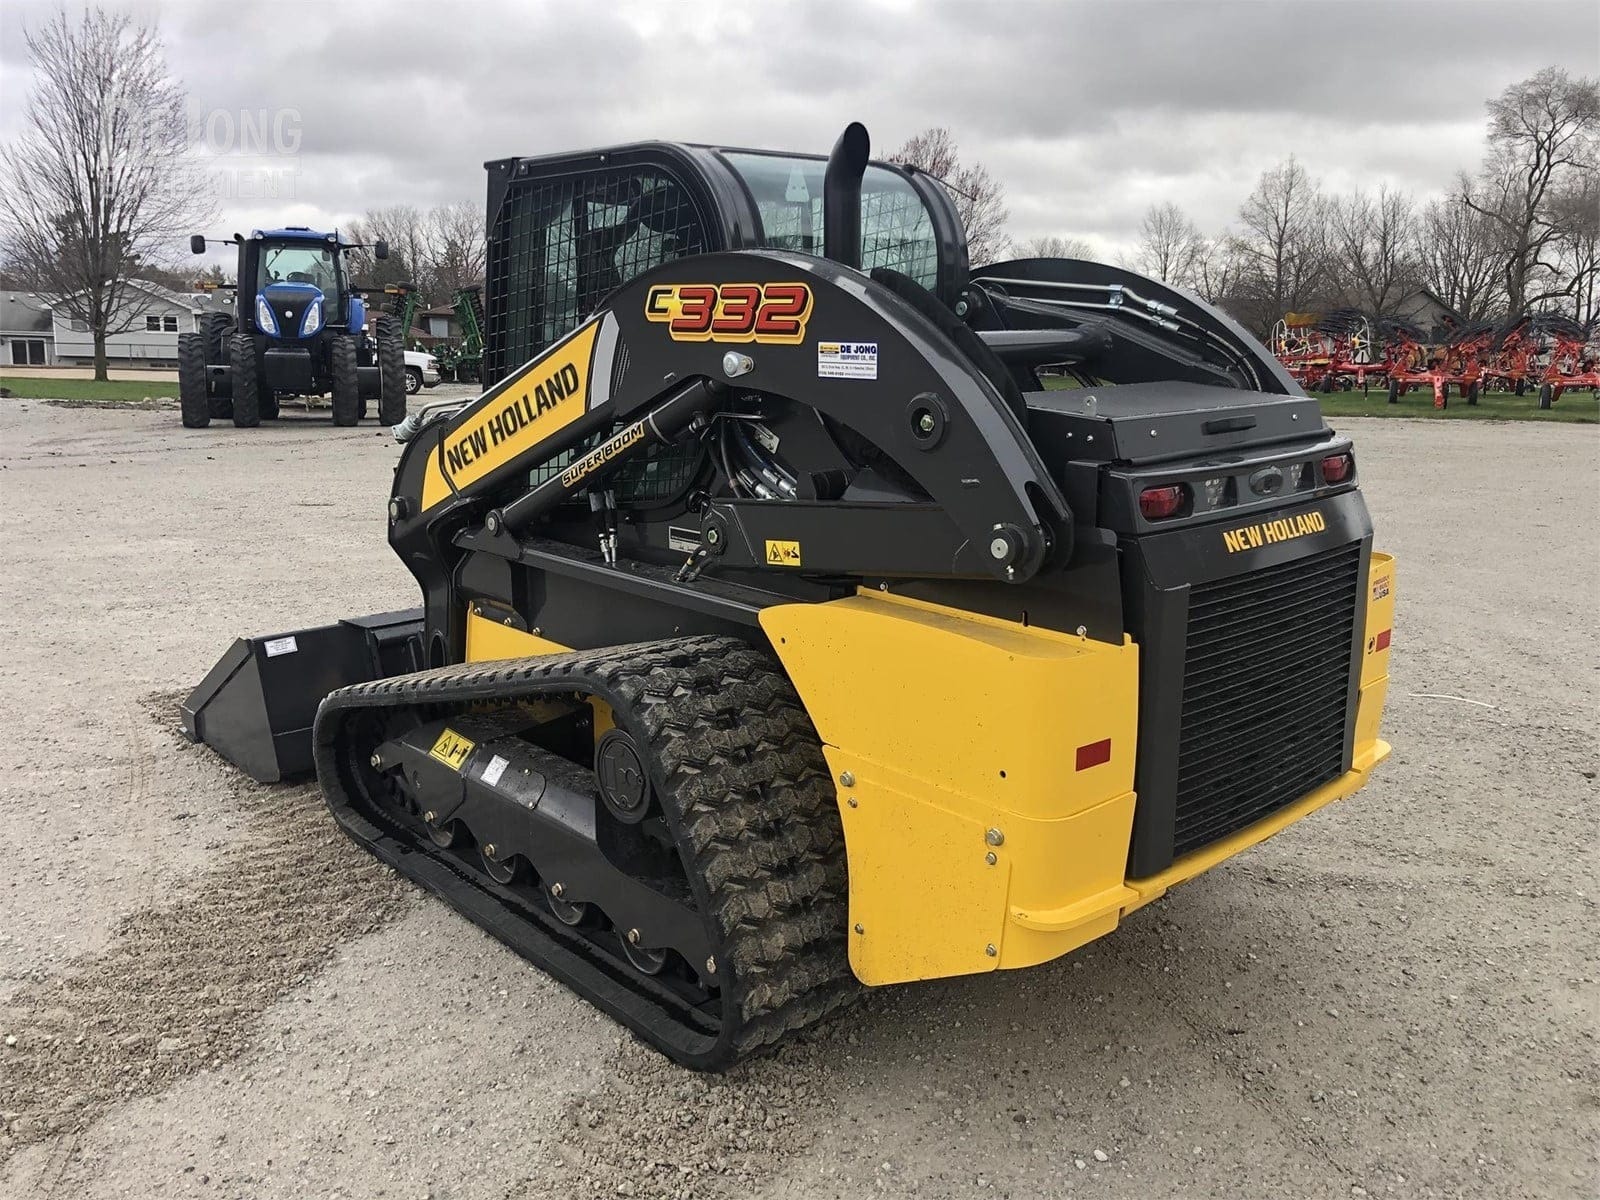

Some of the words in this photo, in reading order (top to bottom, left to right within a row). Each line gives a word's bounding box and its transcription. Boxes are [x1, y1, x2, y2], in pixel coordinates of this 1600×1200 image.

[645, 282, 814, 345] C332
[840, 344, 852, 354] DE
[853, 345, 877, 355] JONG
[446, 425, 489, 475] NEW
[488, 362, 580, 447] HOLLAND
[562, 449, 604, 487] SUPER
[604, 420, 645, 456] BOOM
[1222, 525, 1264, 553] NEW
[1262, 511, 1326, 544] HOLLAND
